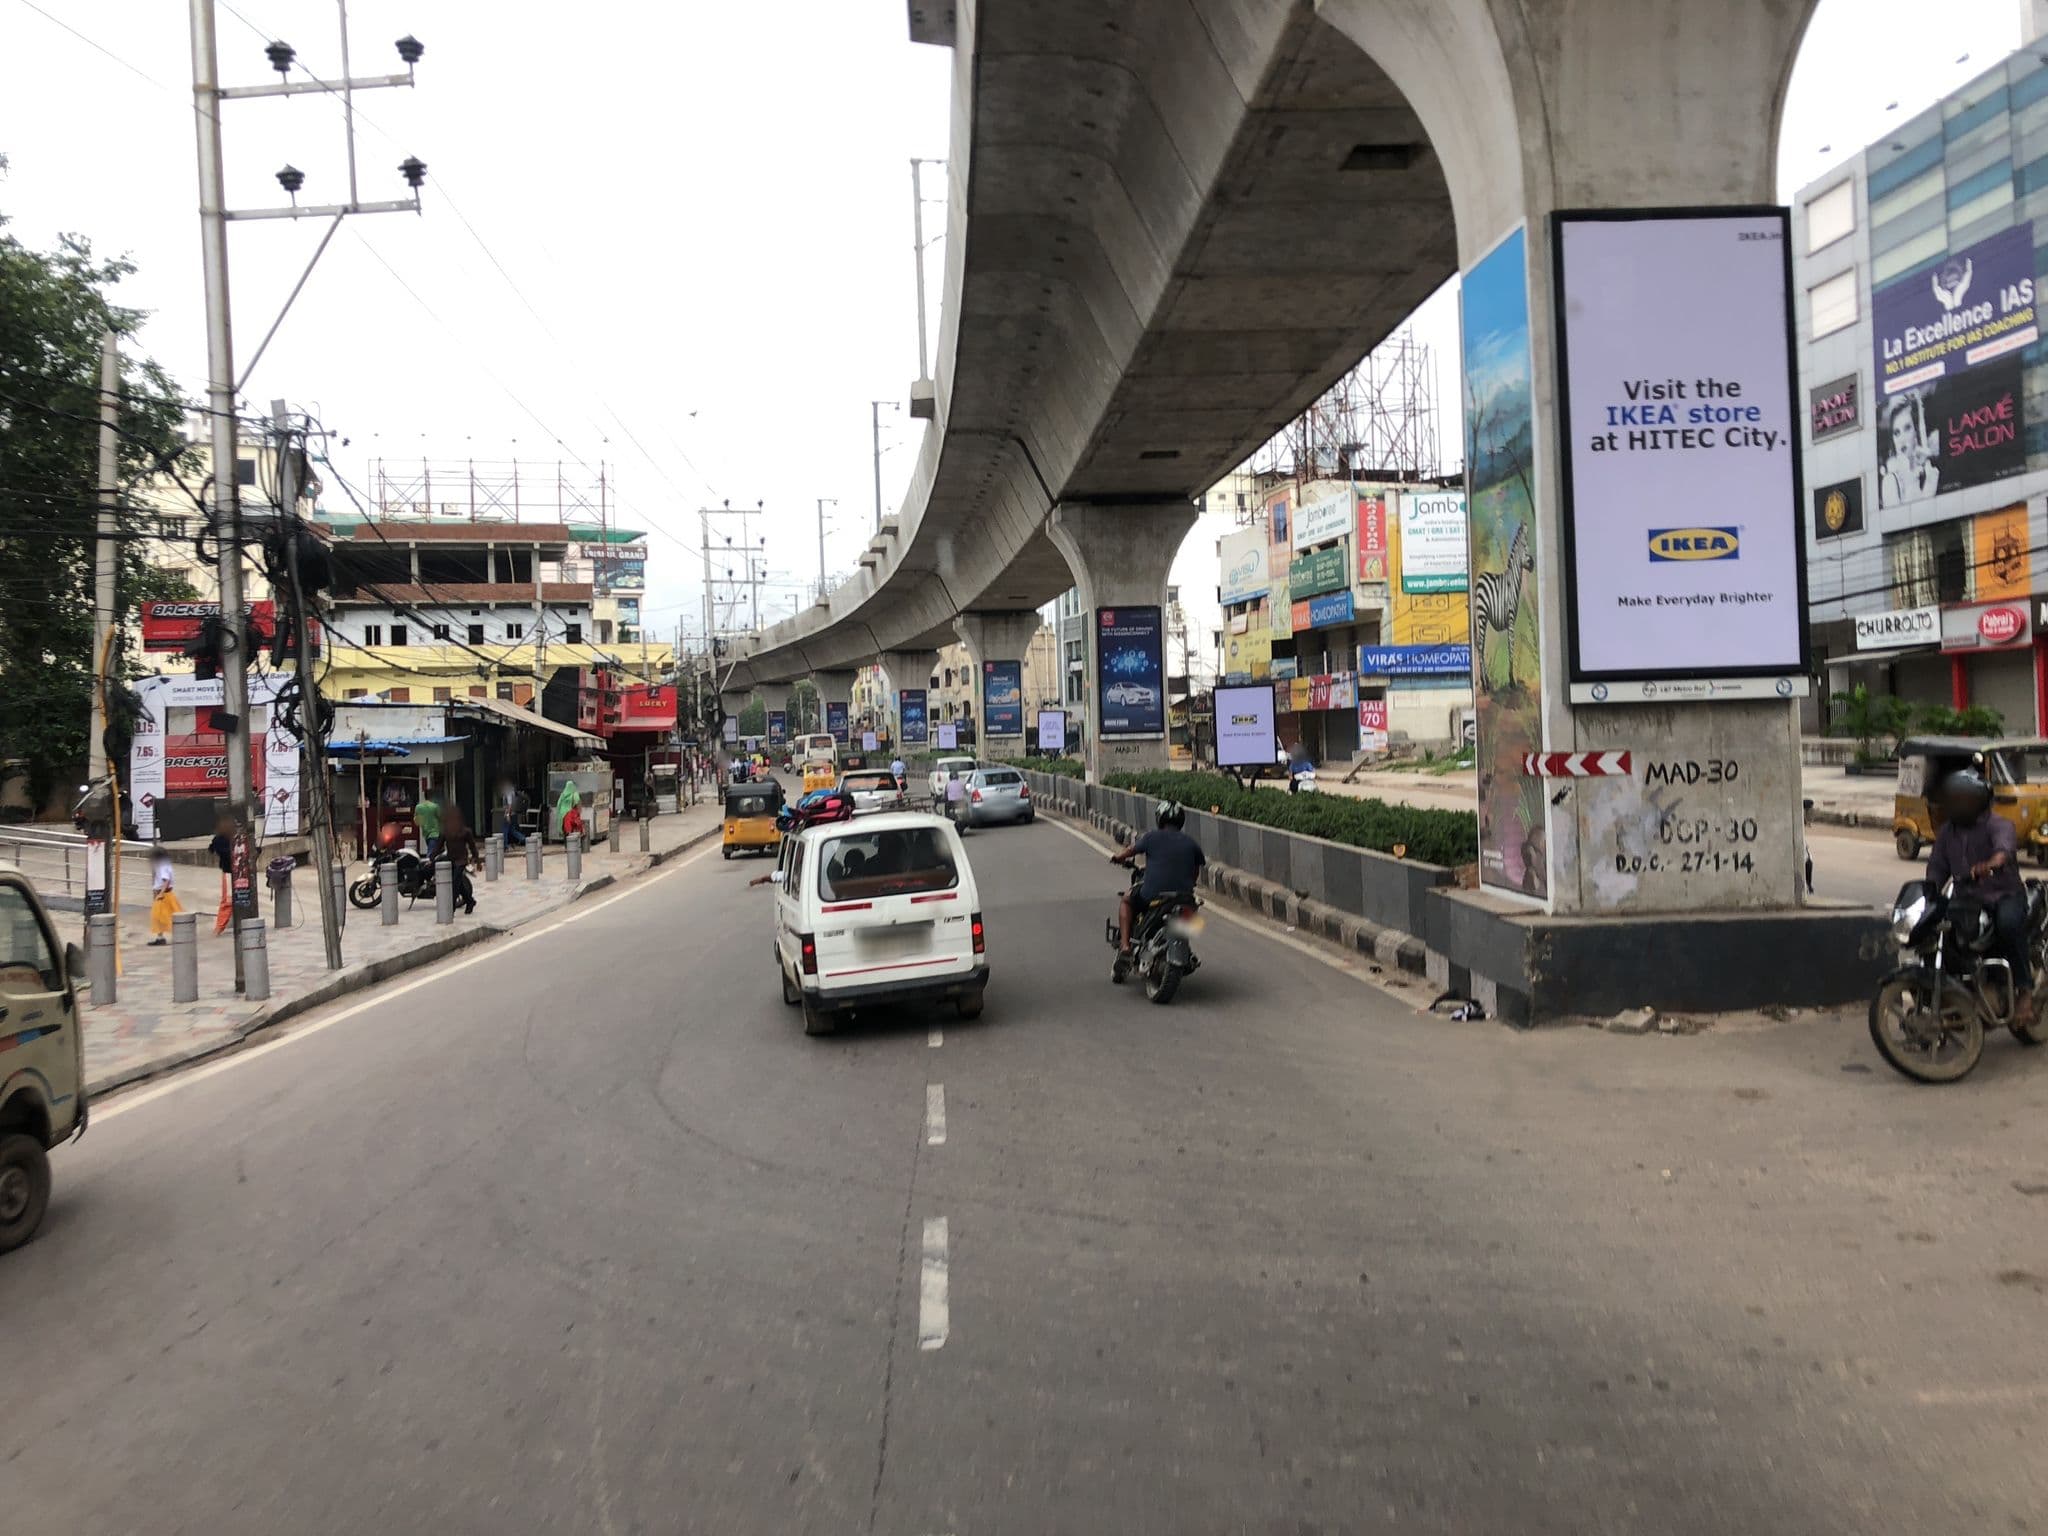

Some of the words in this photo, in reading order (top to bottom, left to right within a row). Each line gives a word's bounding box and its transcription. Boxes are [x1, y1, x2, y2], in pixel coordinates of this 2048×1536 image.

[1883, 338, 1903, 359] La
[1904, 301, 1993, 350] Excellence
[2001, 278, 2033, 313] IAS
[1904, 342, 1947, 368] INSTITUTE
[1948, 335, 1966, 350] FOR
[1967, 328, 1983, 344] IAS
[1983, 307, 2034, 337] COACHING
[1624, 378, 1686, 400] Visit
[1696, 378, 1741, 398] the
[1606, 405, 1675, 426] IKEA
[1689, 405, 1761, 424] store
[1948, 392, 2014, 435] LAKMÉ
[1591, 432, 1618, 451] at
[1629, 428, 1715, 450] HITEC
[1725, 427, 1787, 451] City.
[1948, 421, 2016, 457] SALON
[619, 549, 646, 559] GRAND
[1660, 537, 1729, 552] IKEA
[1618, 596, 1652, 607] Make
[1656, 594, 1715, 607] Everyday
[1720, 592, 1773, 605] Brighter
[1857, 613, 1932, 636] CHURROLTO
[1362, 702, 1384, 713] SALE
[1645, 759, 1738, 786] MAD-30
[1681, 851, 1753, 873] 27-1-14
